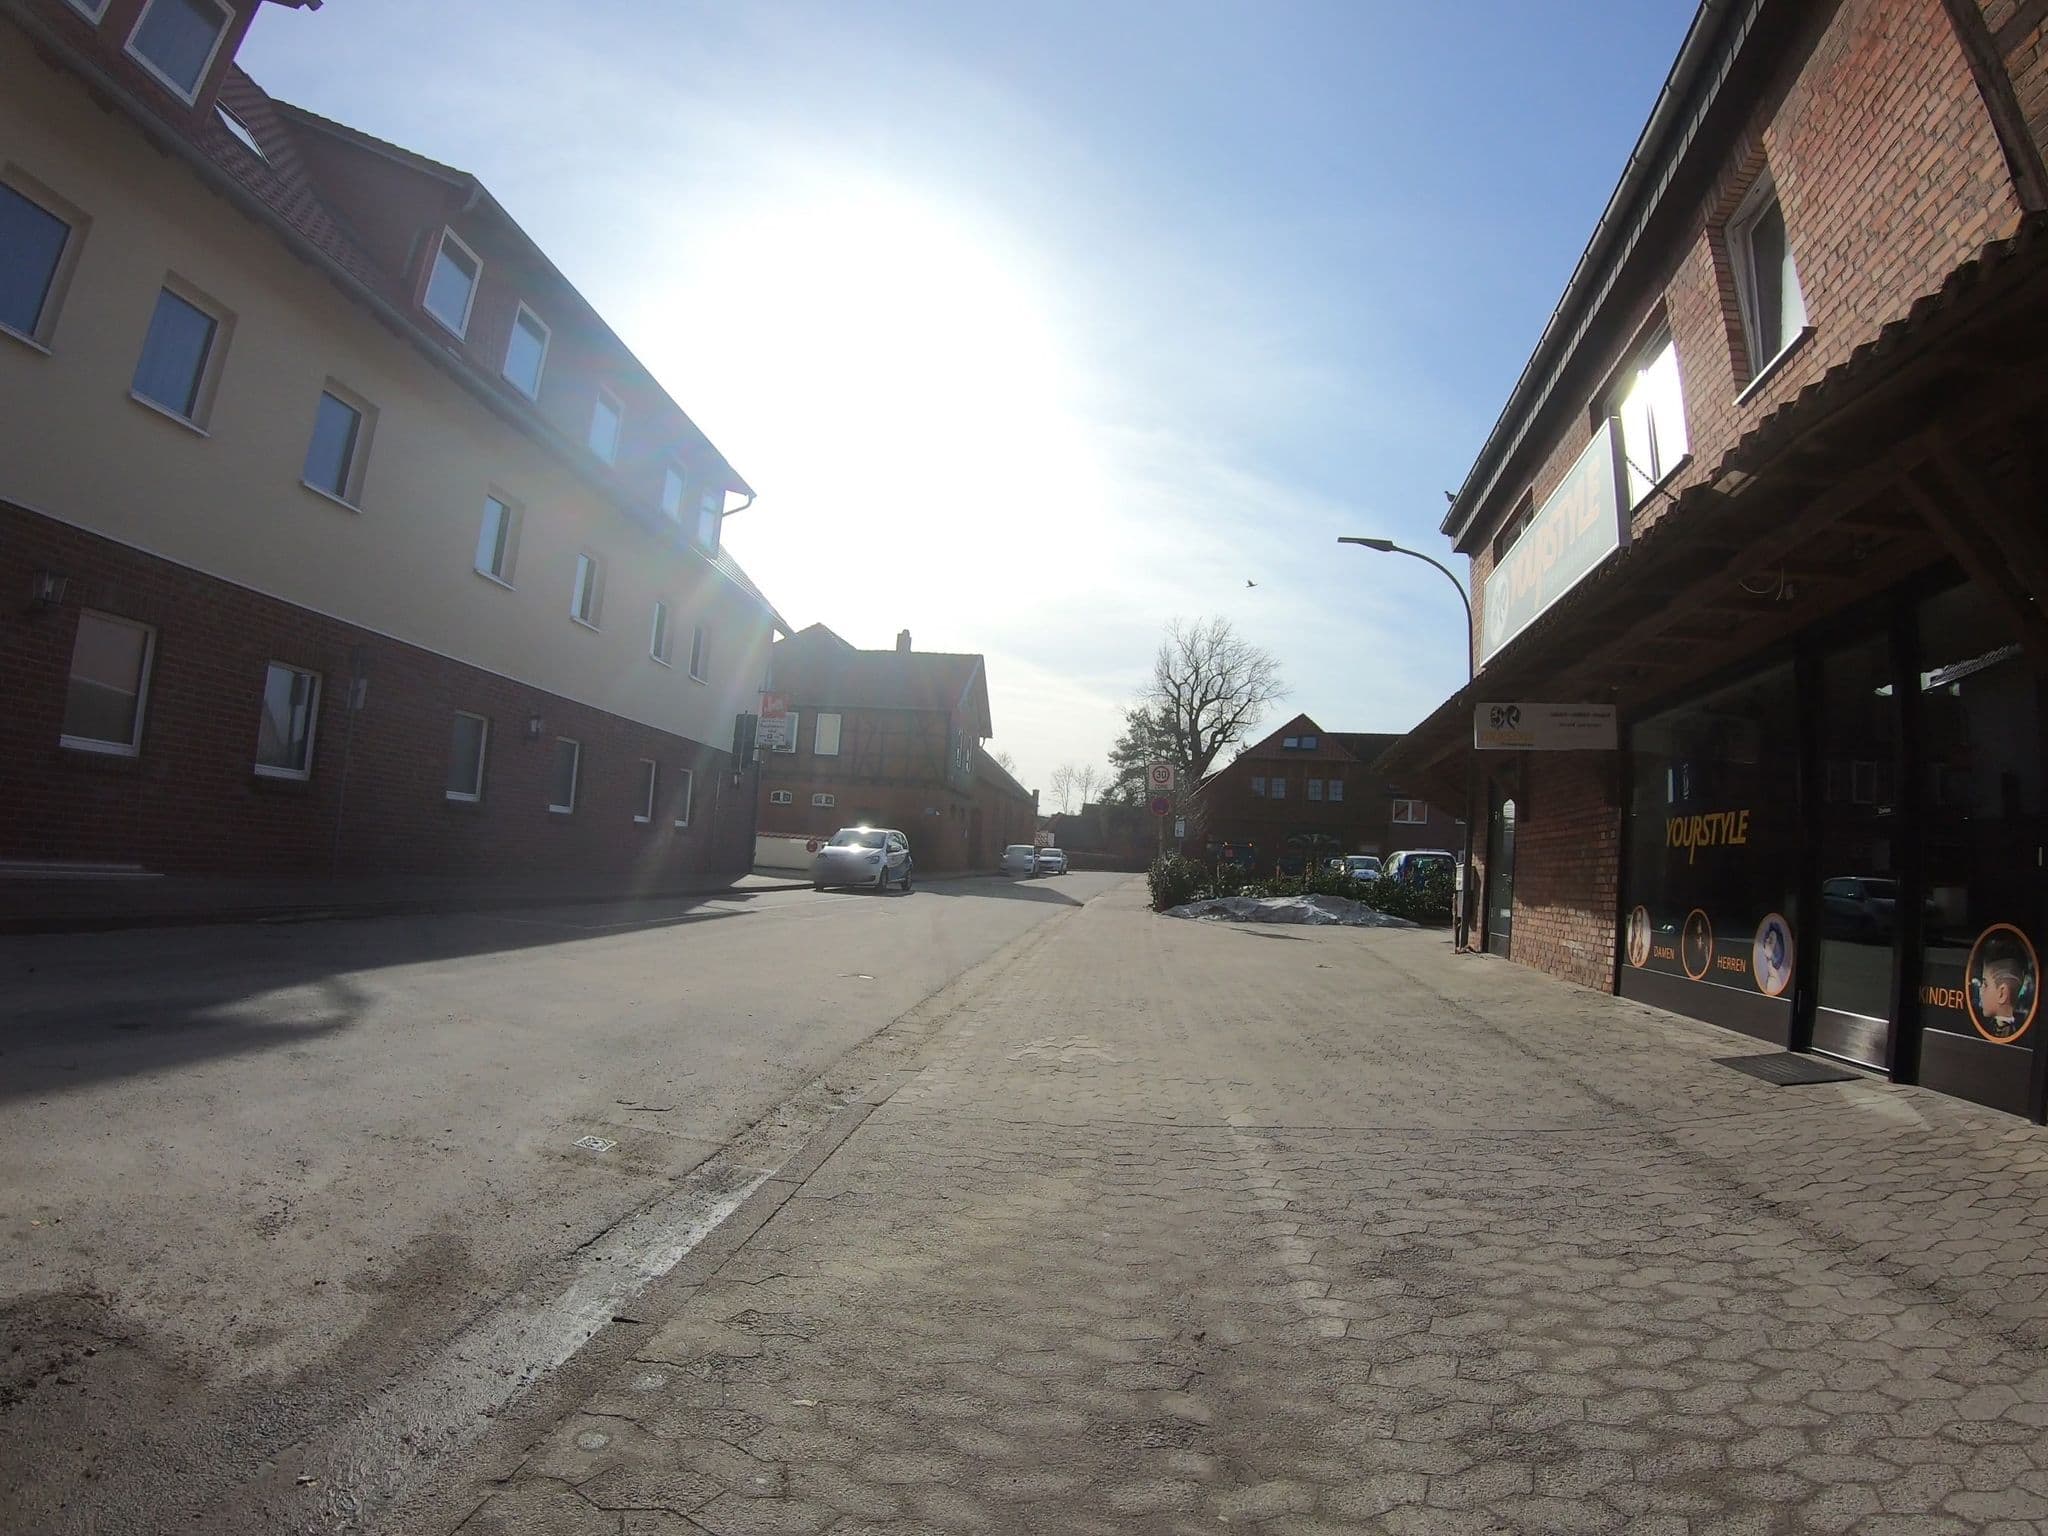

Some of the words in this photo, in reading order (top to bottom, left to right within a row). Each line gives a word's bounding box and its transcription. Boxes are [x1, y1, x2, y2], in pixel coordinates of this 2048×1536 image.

[1156, 770, 1167, 779] 30
[1666, 809, 1750, 864] YOURSTYLE
[1653, 945, 1675, 960] DAMEN
[1717, 955, 1746, 972] HERREN
[1919, 985, 1964, 1009] KINDER
